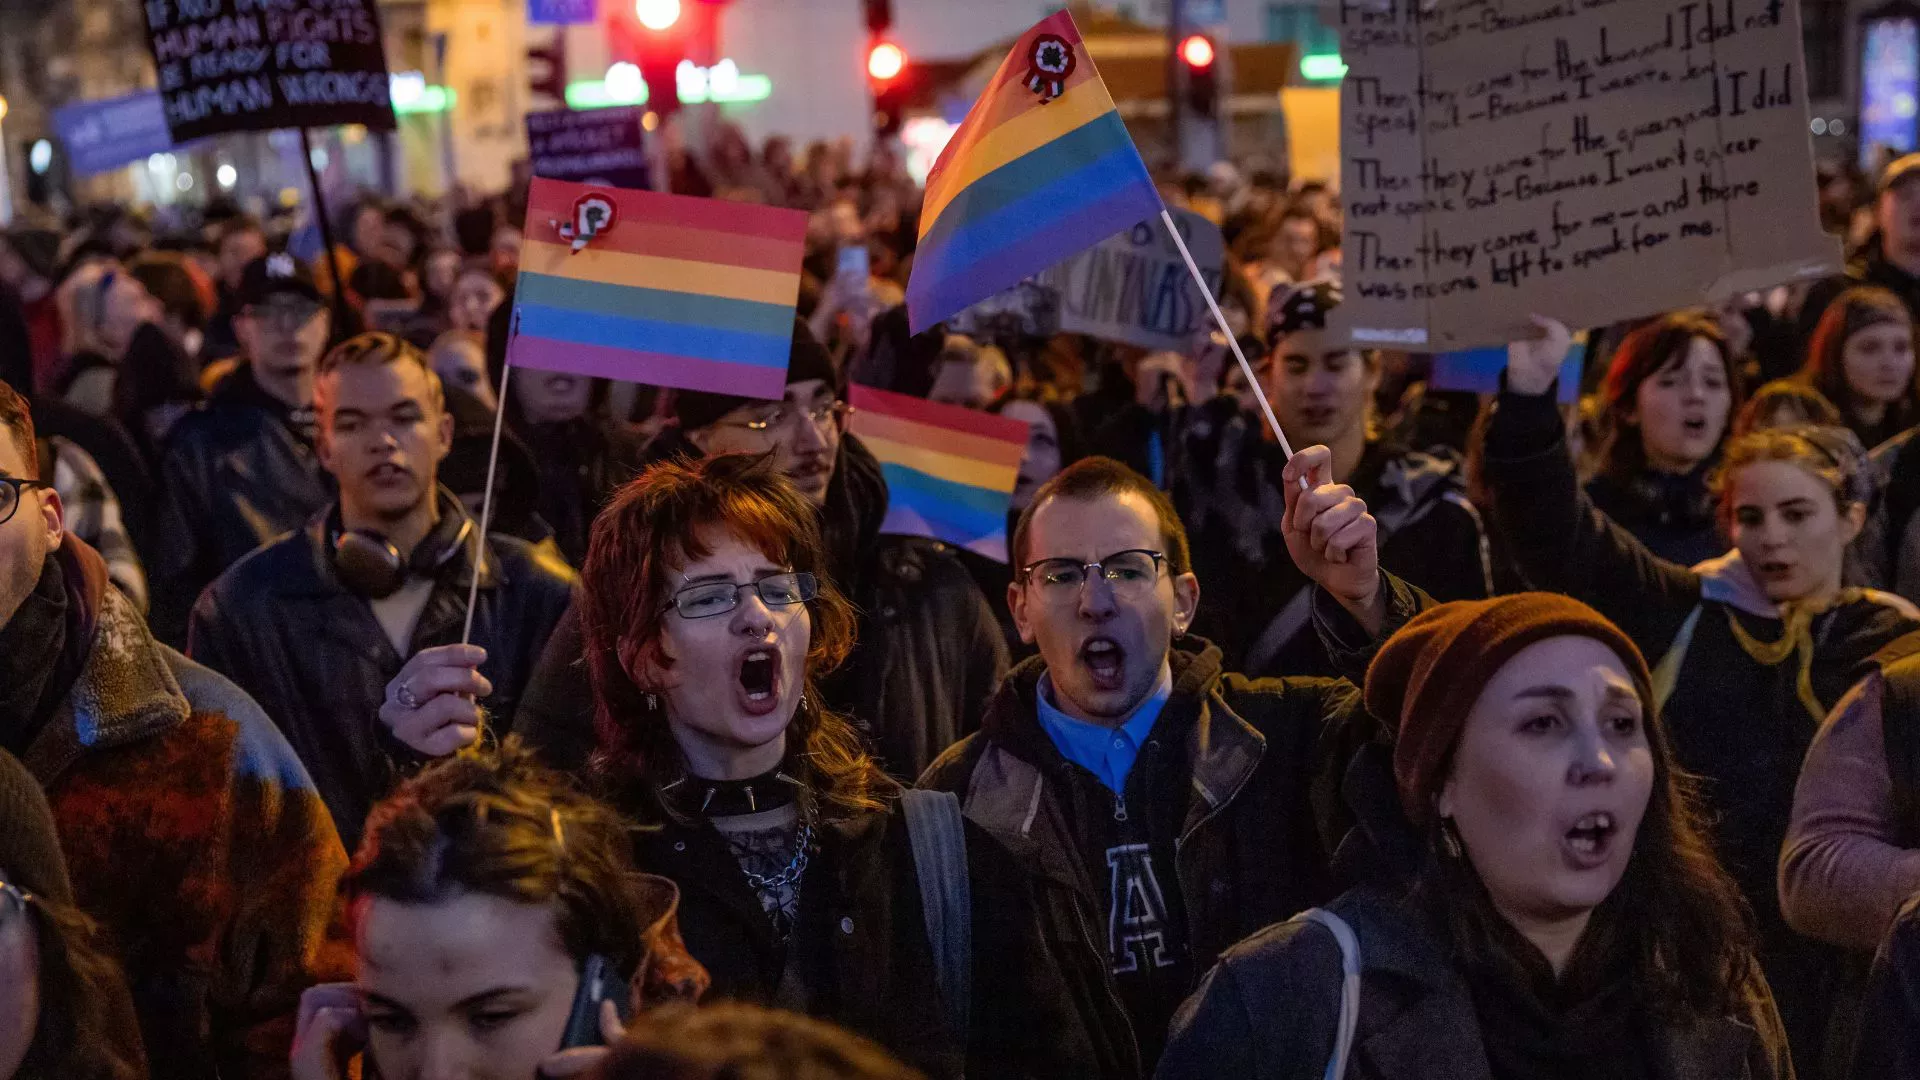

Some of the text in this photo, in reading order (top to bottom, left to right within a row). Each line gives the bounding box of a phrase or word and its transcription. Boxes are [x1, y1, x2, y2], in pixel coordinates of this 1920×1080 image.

[153, 7, 375, 60] HUMAN RIGHTS
[190, 47, 271, 78] READY
[275, 41, 331, 68] FOR
[1350, 76, 1405, 107] Then
[1555, 37, 1587, 81] the
[1679, 3, 1698, 51] I
[1696, 0, 1737, 43] did
[1744, 0, 1783, 29] not
[165, 74, 273, 122] HUMAN
[1573, 73, 1595, 99] I
[1351, 158, 1411, 191] Then
[1417, 146, 1476, 197] they
[1572, 115, 1606, 156] the
[1727, 71, 1748, 116] I
[1752, 62, 1792, 109] did
[1351, 194, 1388, 218] not
[1603, 149, 1623, 185] I
[1349, 231, 1416, 272] Then
[1415, 227, 1477, 279] they
[1482, 228, 1538, 254] came
[1550, 200, 1583, 250] for
[1696, 173, 1760, 206] there
[1357, 280, 1408, 300] was
[1490, 249, 1534, 288] left
[1538, 248, 1564, 276] to
[1631, 221, 1670, 253] for
[1105, 843, 1175, 975] A
